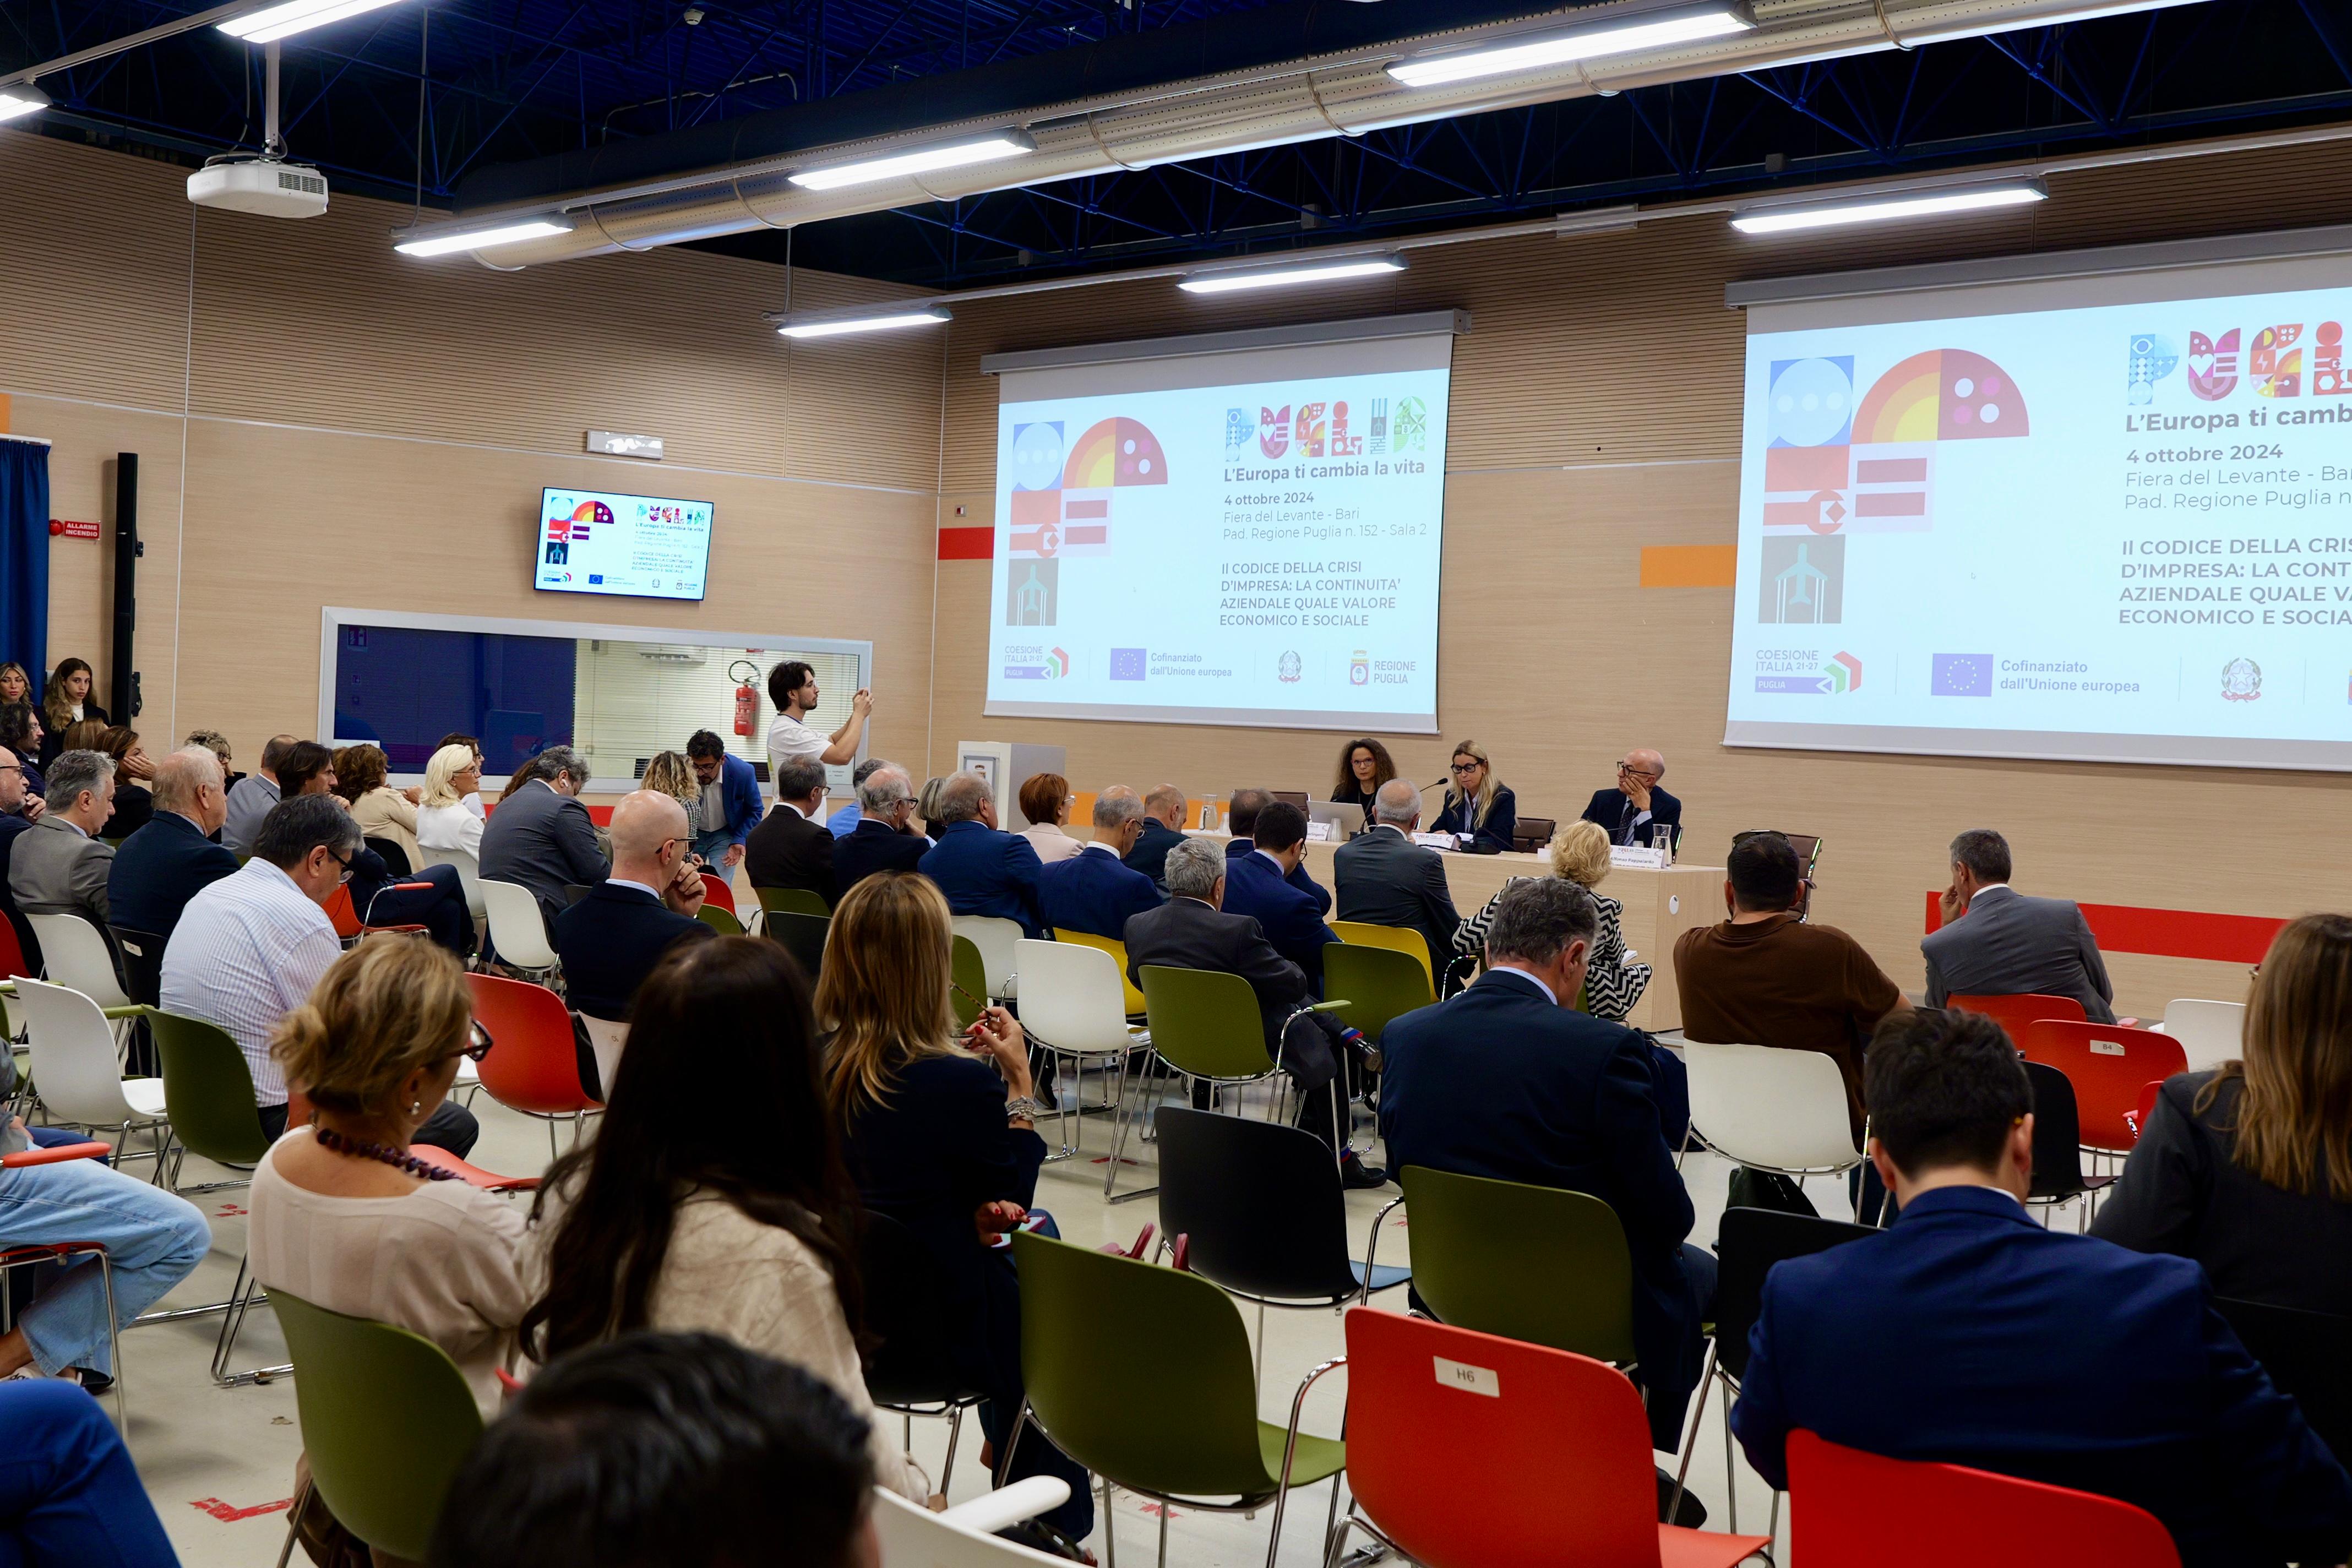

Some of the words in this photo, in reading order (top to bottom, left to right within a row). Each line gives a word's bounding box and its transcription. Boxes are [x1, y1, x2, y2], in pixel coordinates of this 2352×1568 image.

[2248, 406, 2267, 426] ti
[1226, 396, 1427, 462] PUGLIA
[2126, 449, 2139, 464] 4
[2145, 447, 2223, 463] ottobre
[2230, 444, 2283, 460] 2024
[1295, 464, 1305, 478] ti
[1310, 461, 1369, 478] cambia
[1375, 461, 1388, 475] la
[1394, 459, 1425, 474] vita
[2126, 472, 2173, 487] Fiera
[2180, 470, 2210, 486] del
[2218, 468, 2300, 484] Levante
[2322, 466, 2352, 481] Ba
[1224, 495, 1232, 505] 4
[1235, 493, 1280, 505] ottobre
[1284, 492, 1314, 503] 2024
[2125, 493, 2167, 509] Pad.
[2174, 492, 2257, 511] Regione
[2266, 489, 2331, 509] Puglia
[1224, 511, 1251, 523] Fiera
[1255, 510, 1272, 522] del
[1277, 509, 1324, 521] Levante
[1336, 507, 1359, 519] Bari
[1223, 528, 1248, 540] Pad.
[1251, 527, 1299, 541] Regione
[1304, 525, 1341, 540] Puglia
[1345, 527, 1356, 537] n.
[1360, 525, 1378, 536] 152
[1390, 524, 1415, 536] Sala
[1419, 524, 1427, 535] 2
[2140, 540, 2223, 555] CODICE
[2230, 538, 2302, 554] DELLA
[1232, 563, 1279, 574] CODICE
[1283, 562, 1324, 573] DELLA
[1328, 561, 1362, 573] CRISI
[2252, 563, 2280, 578] LA
[2286, 562, 2351, 577] CONT
[1296, 580, 1311, 591] LA
[2119, 587, 2242, 602] AZIENDALE
[2249, 586, 2327, 605] QUALE
[1220, 598, 1291, 608] AZIENDALE
[1294, 597, 1338, 611] QUALE
[1342, 597, 1396, 608] VALORE
[1220, 615, 1297, 625] ECONOMICO
[1302, 615, 1309, 625] E
[1313, 615, 1369, 626] SOCIALE
[2119, 609, 2255, 624] ECONOMICO
[2263, 610, 2275, 624] E
[1005, 646, 1043, 654] COESIONE
[1756, 650, 1819, 661] COESIONE
[1005, 655, 1028, 663] ITALIA
[1151, 653, 1202, 663] Cofinanziato
[1151, 666, 1196, 676] dall'Unione
[1198, 668, 1232, 679] europea
[1374, 661, 1416, 671] REGIONE
[1756, 661, 1793, 672] ITALIA
[1796, 662, 1819, 671] 21-27
[2001, 660, 2088, 673] Cofinanziato
[1374, 673, 1408, 684] PUGLIA
[1758, 680, 1786, 689] PUGLIA
[2000, 677, 2078, 691] dall'Unione
[2082, 680, 2140, 694] europea
[1457, 1368, 1475, 1383] H6
